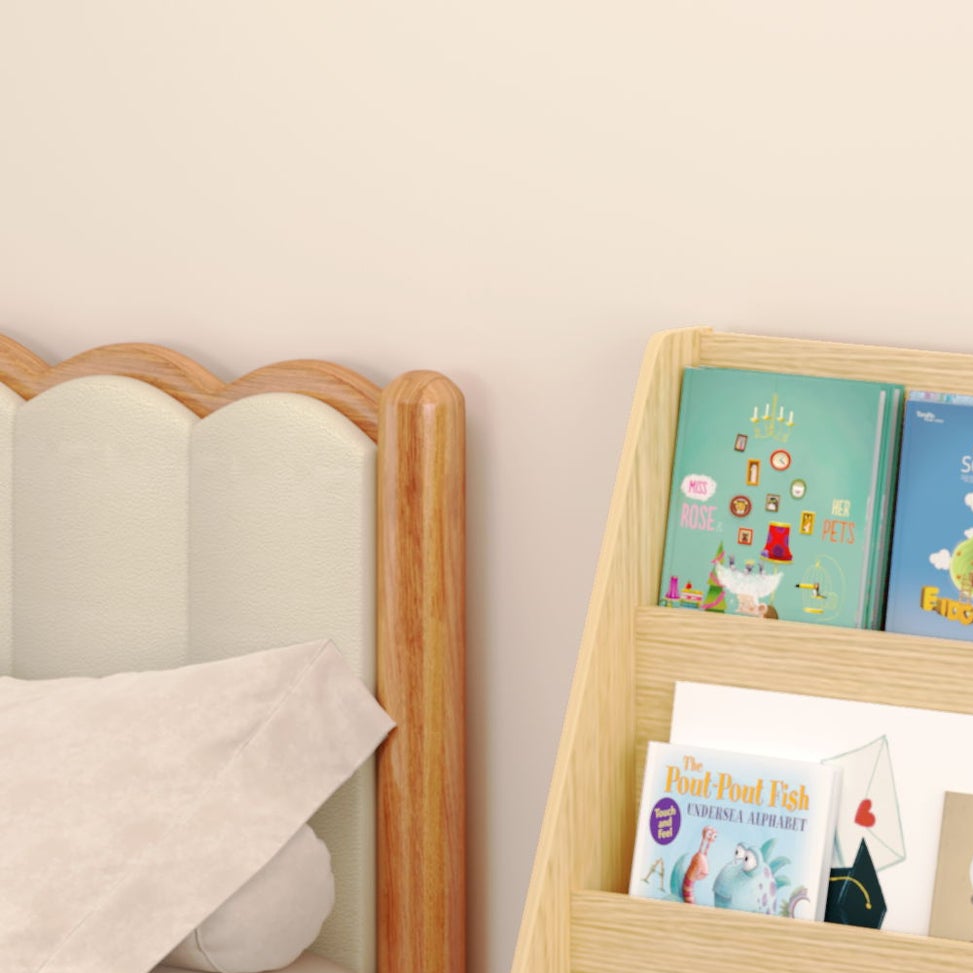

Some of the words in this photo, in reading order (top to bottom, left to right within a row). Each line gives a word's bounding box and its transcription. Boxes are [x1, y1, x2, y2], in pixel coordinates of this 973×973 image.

[688, 479, 708, 495] MISS
[680, 502, 717, 531] ROSE
[831, 498, 852, 518] HER
[821, 518, 857, 544] PETS
[683, 755, 704, 772] The
[664, 764, 765, 806] Pout-Pout
[768, 778, 810, 812] Fish
[654, 804, 677, 818] Touch
[687, 802, 744, 823] UNDERSEA
[748, 812, 808, 832] ALPHABET
[657, 818, 673, 829] and
[657, 828, 673, 840] Feel
